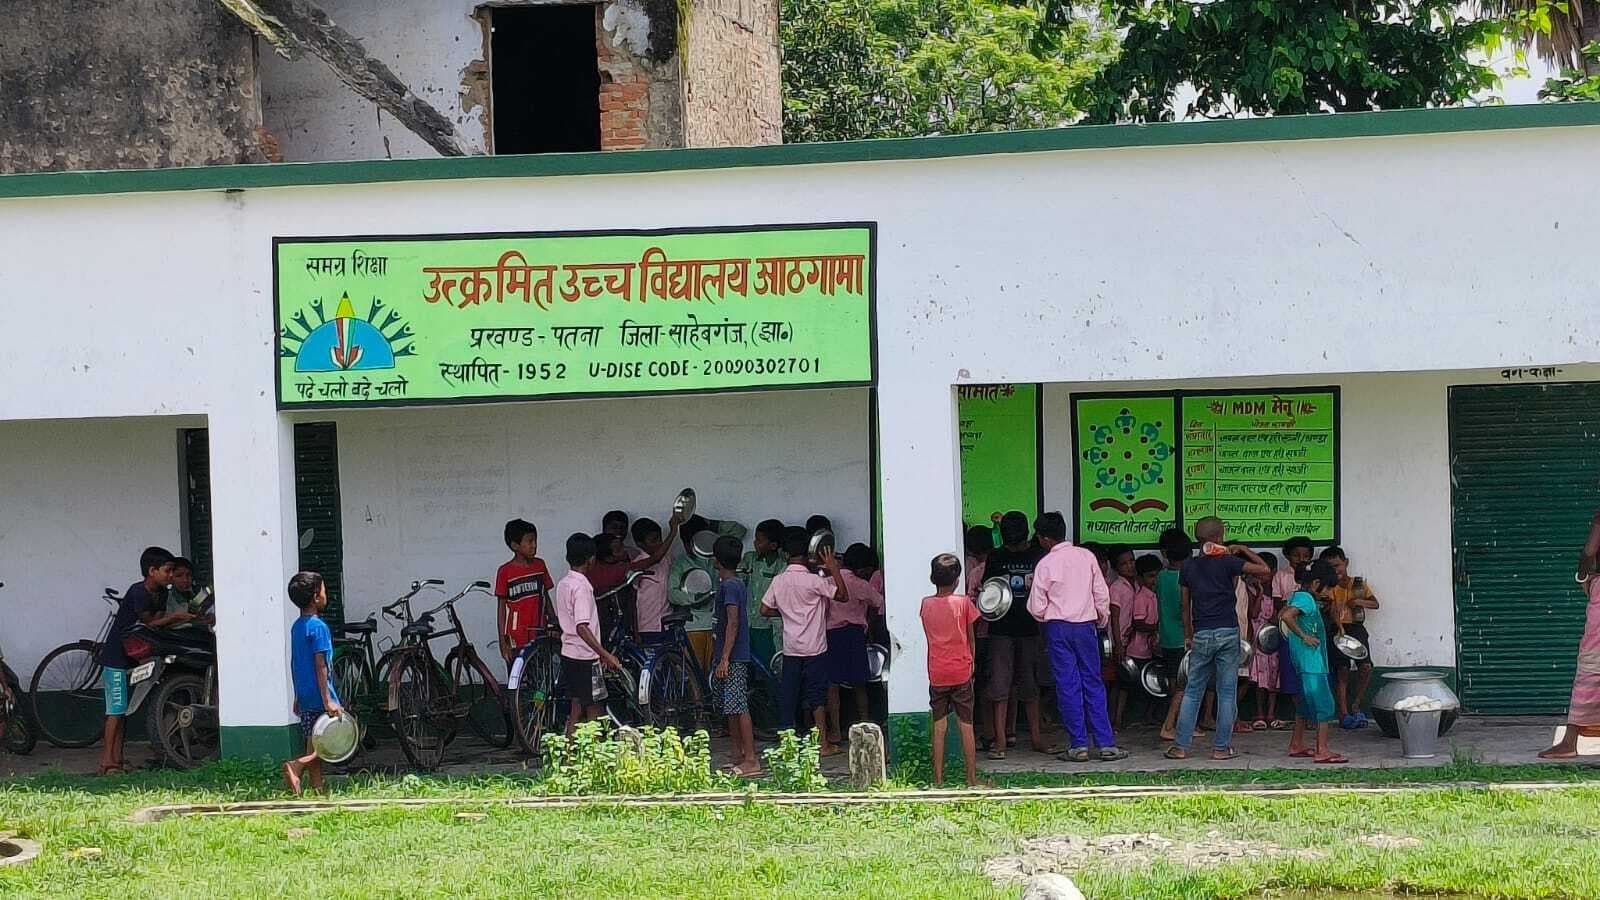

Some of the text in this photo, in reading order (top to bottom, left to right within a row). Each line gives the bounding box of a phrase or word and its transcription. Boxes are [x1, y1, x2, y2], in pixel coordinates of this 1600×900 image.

[305, 249, 388, 280] समग्र शिक्षा
[422, 246, 866, 311] उत्क्रमित उच्च विद्यालय आठगामा
[551, 326, 604, 351] पतना
[518, 362, 567, 380] 1952
[588, 360, 643, 379] U-DISE
[703, 356, 820, 376] 20090302701
[318, 375, 349, 399] चलो
[375, 374, 408, 397] चलो
[1232, 402, 1265, 415] MDM
